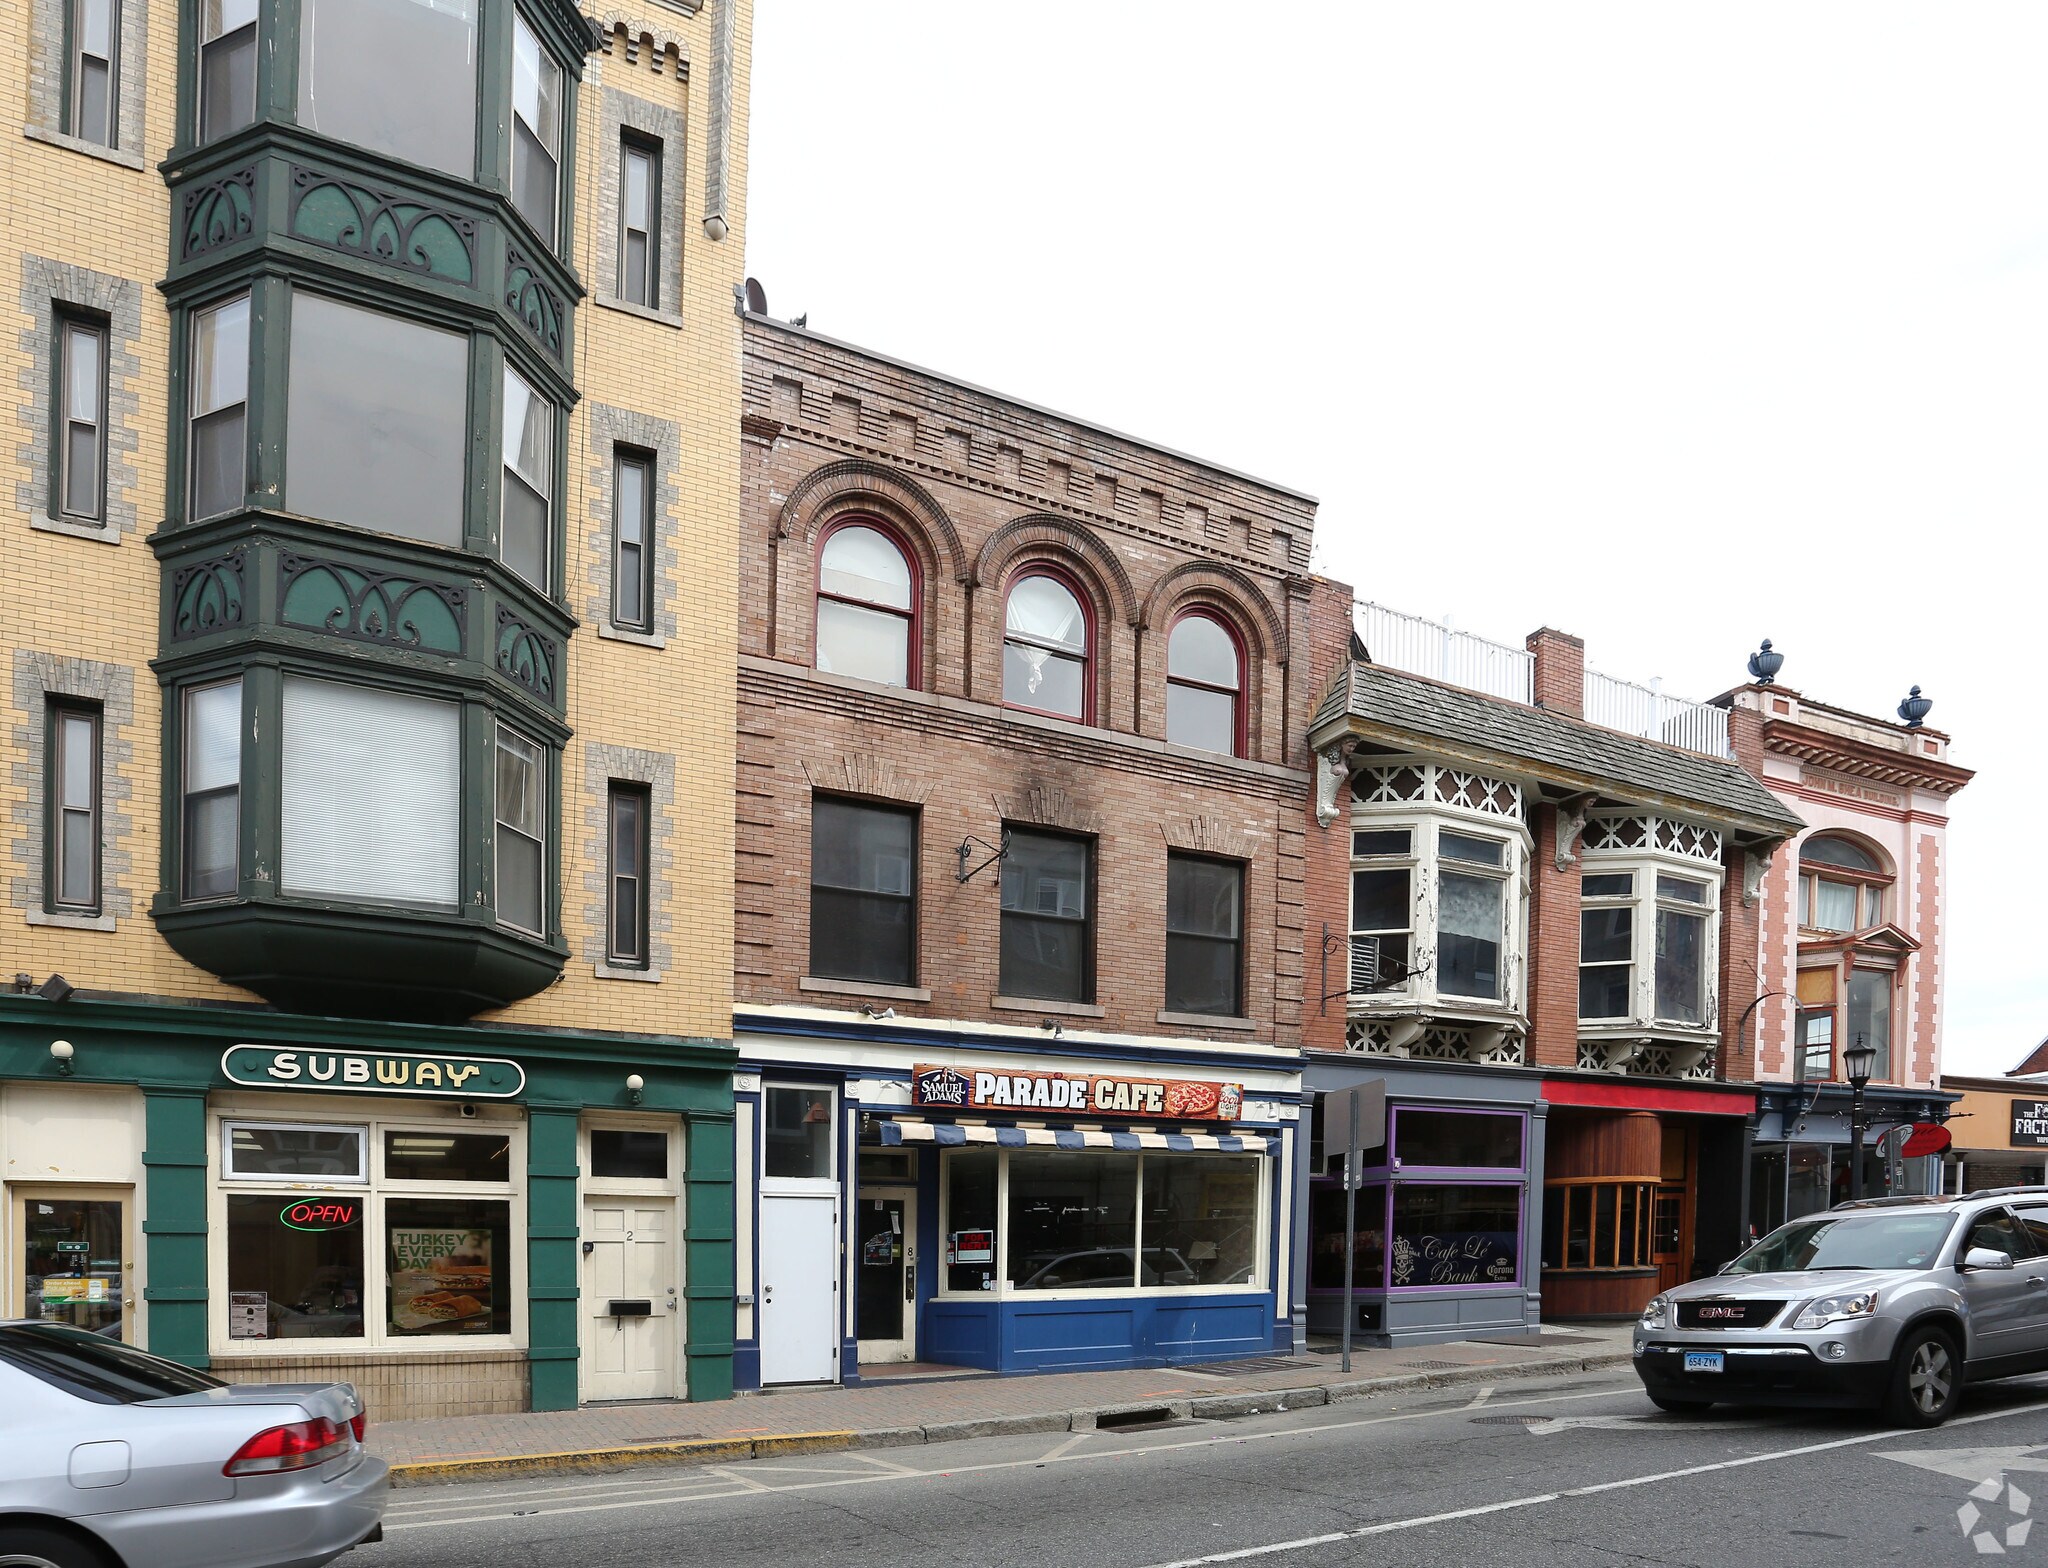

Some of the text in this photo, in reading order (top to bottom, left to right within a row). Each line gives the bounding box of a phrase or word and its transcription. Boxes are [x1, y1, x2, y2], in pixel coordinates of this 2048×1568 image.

[267, 1053, 480, 1088] SUBWAY
[921, 1080, 966, 1094] SAMUEL
[974, 1072, 1164, 1112] PARADE CAFE
[924, 1090, 962, 1104] ADAMS
[2014, 1118, 2048, 1135] FACT
[291, 1204, 353, 1223] OPEN
[397, 1233, 468, 1246] TURKEY
[626, 1230, 634, 1241] 2
[963, 1233, 985, 1242] FOR
[397, 1246, 456, 1257] EVERY
[908, 1246, 914, 1257] 8
[959, 1241, 989, 1250] RENT
[1420, 1235, 1459, 1262] Cafe
[397, 1258, 432, 1270] DAY
[1487, 1264, 1514, 1276] Corona
[1430, 1261, 1478, 1284] Bank
[1699, 1307, 1745, 1318] GMC
